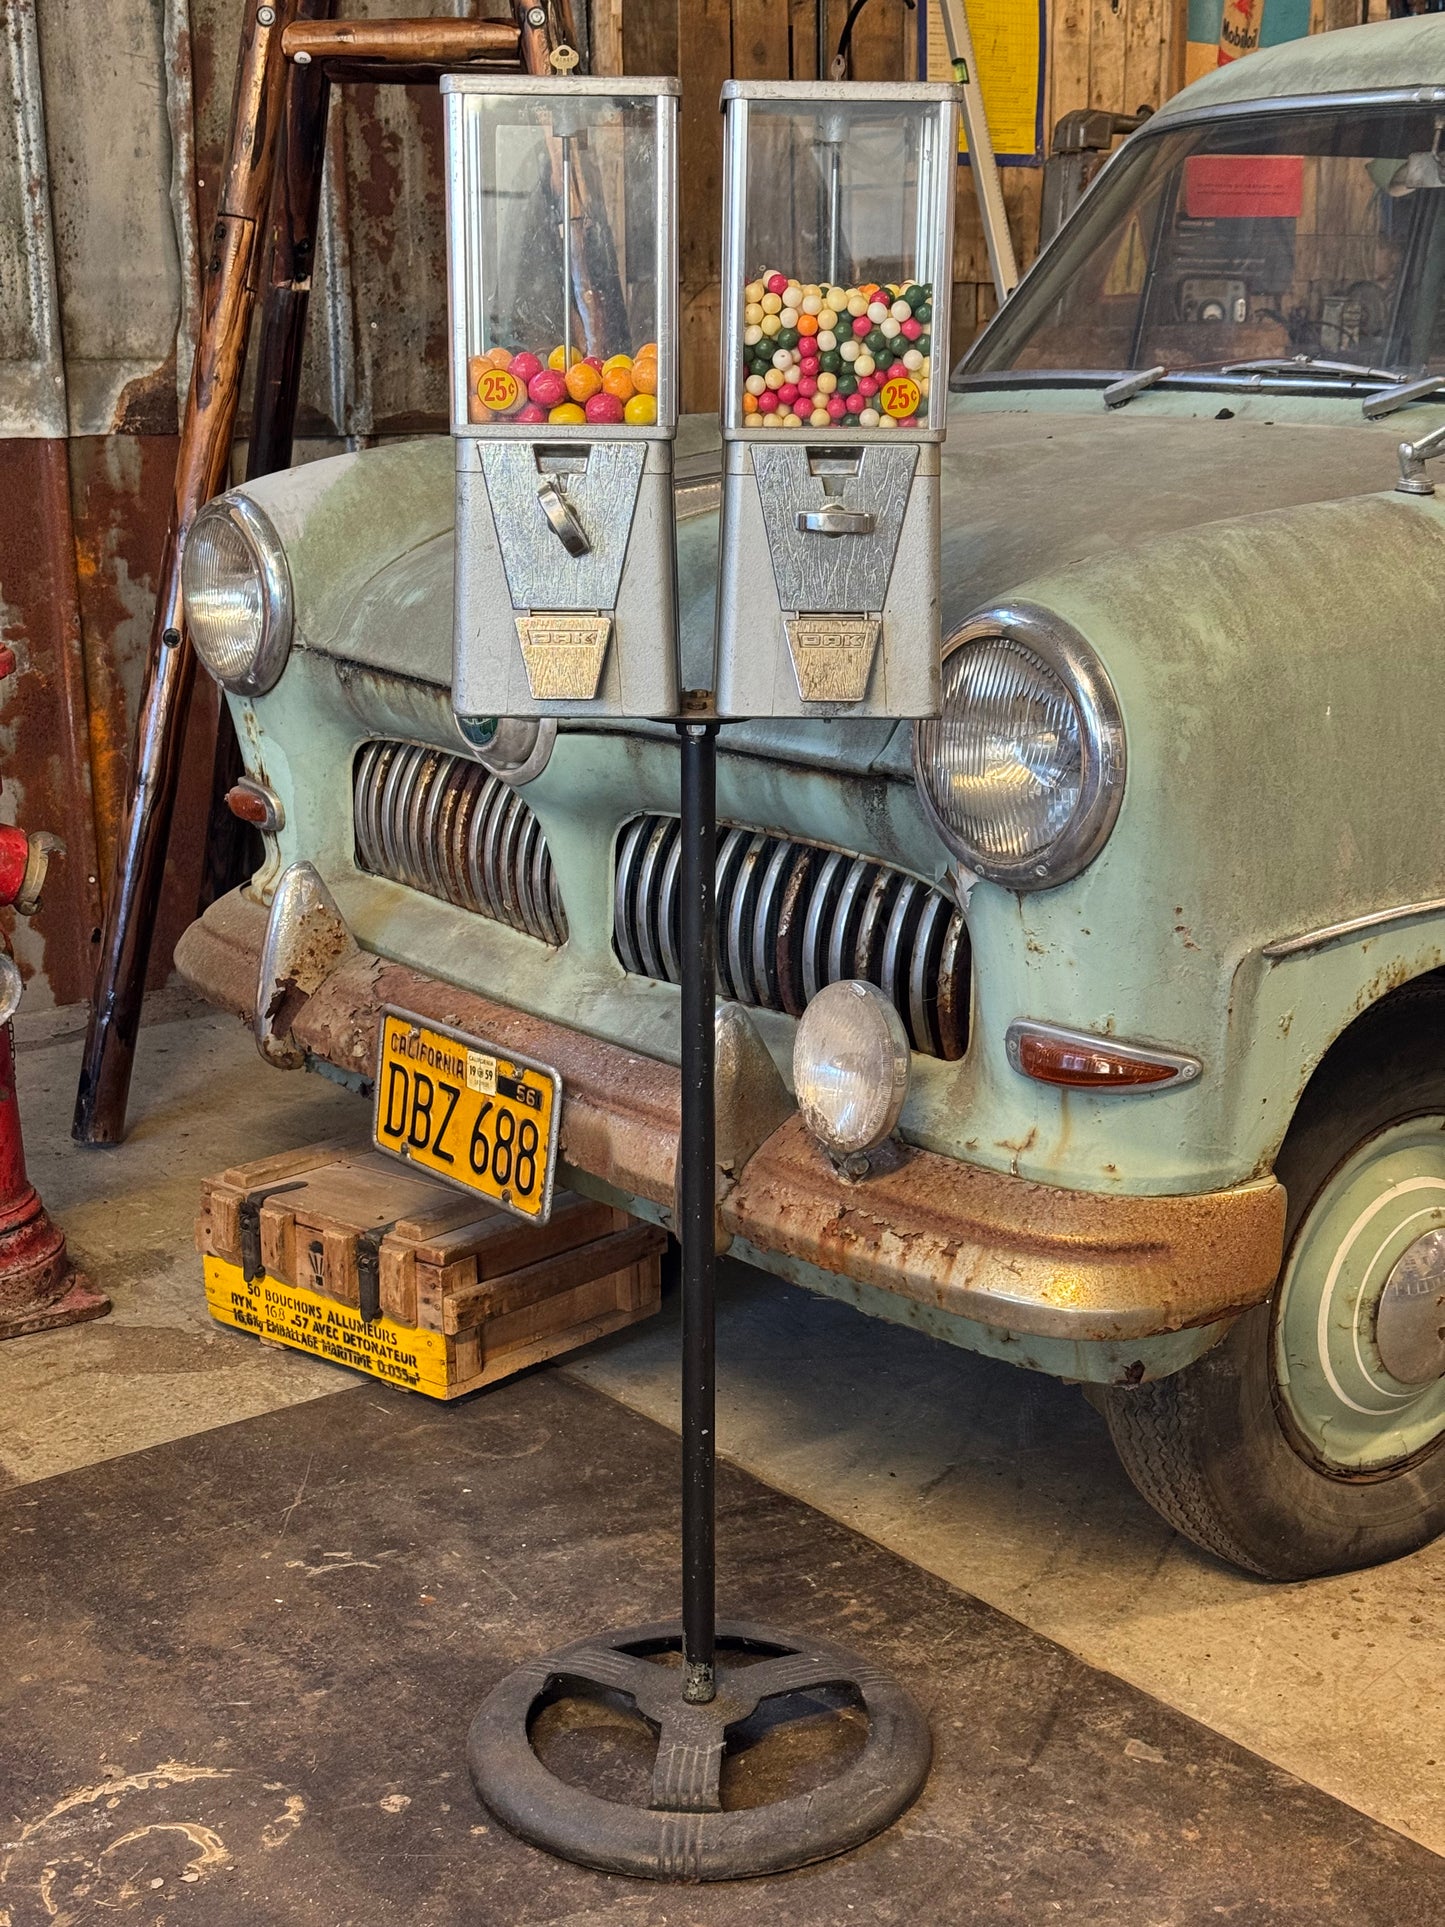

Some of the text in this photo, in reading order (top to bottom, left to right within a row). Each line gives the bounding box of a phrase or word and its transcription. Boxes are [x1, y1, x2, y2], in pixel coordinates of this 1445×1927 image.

[1222, 18, 1258, 49] Mobiloil
[484, 377, 515, 401] 25¢
[886, 384, 917, 410] 25¢
[531, 631, 598, 645] OAK
[801, 634, 863, 647] OAK
[391, 1032, 465, 1080] CALIFORNIA
[515, 1084, 536, 1106] 56
[384, 1061, 539, 1196] DBZ 688
[247, 1283, 397, 1346] 50 BOUCHONS ALLUMEURS
[266, 1319, 319, 1350] EMBALLAGE
[322, 1338, 373, 1370] MARITIME
[312, 1321, 339, 1341] AVEC
[343, 1331, 418, 1369] DETONATEUR
